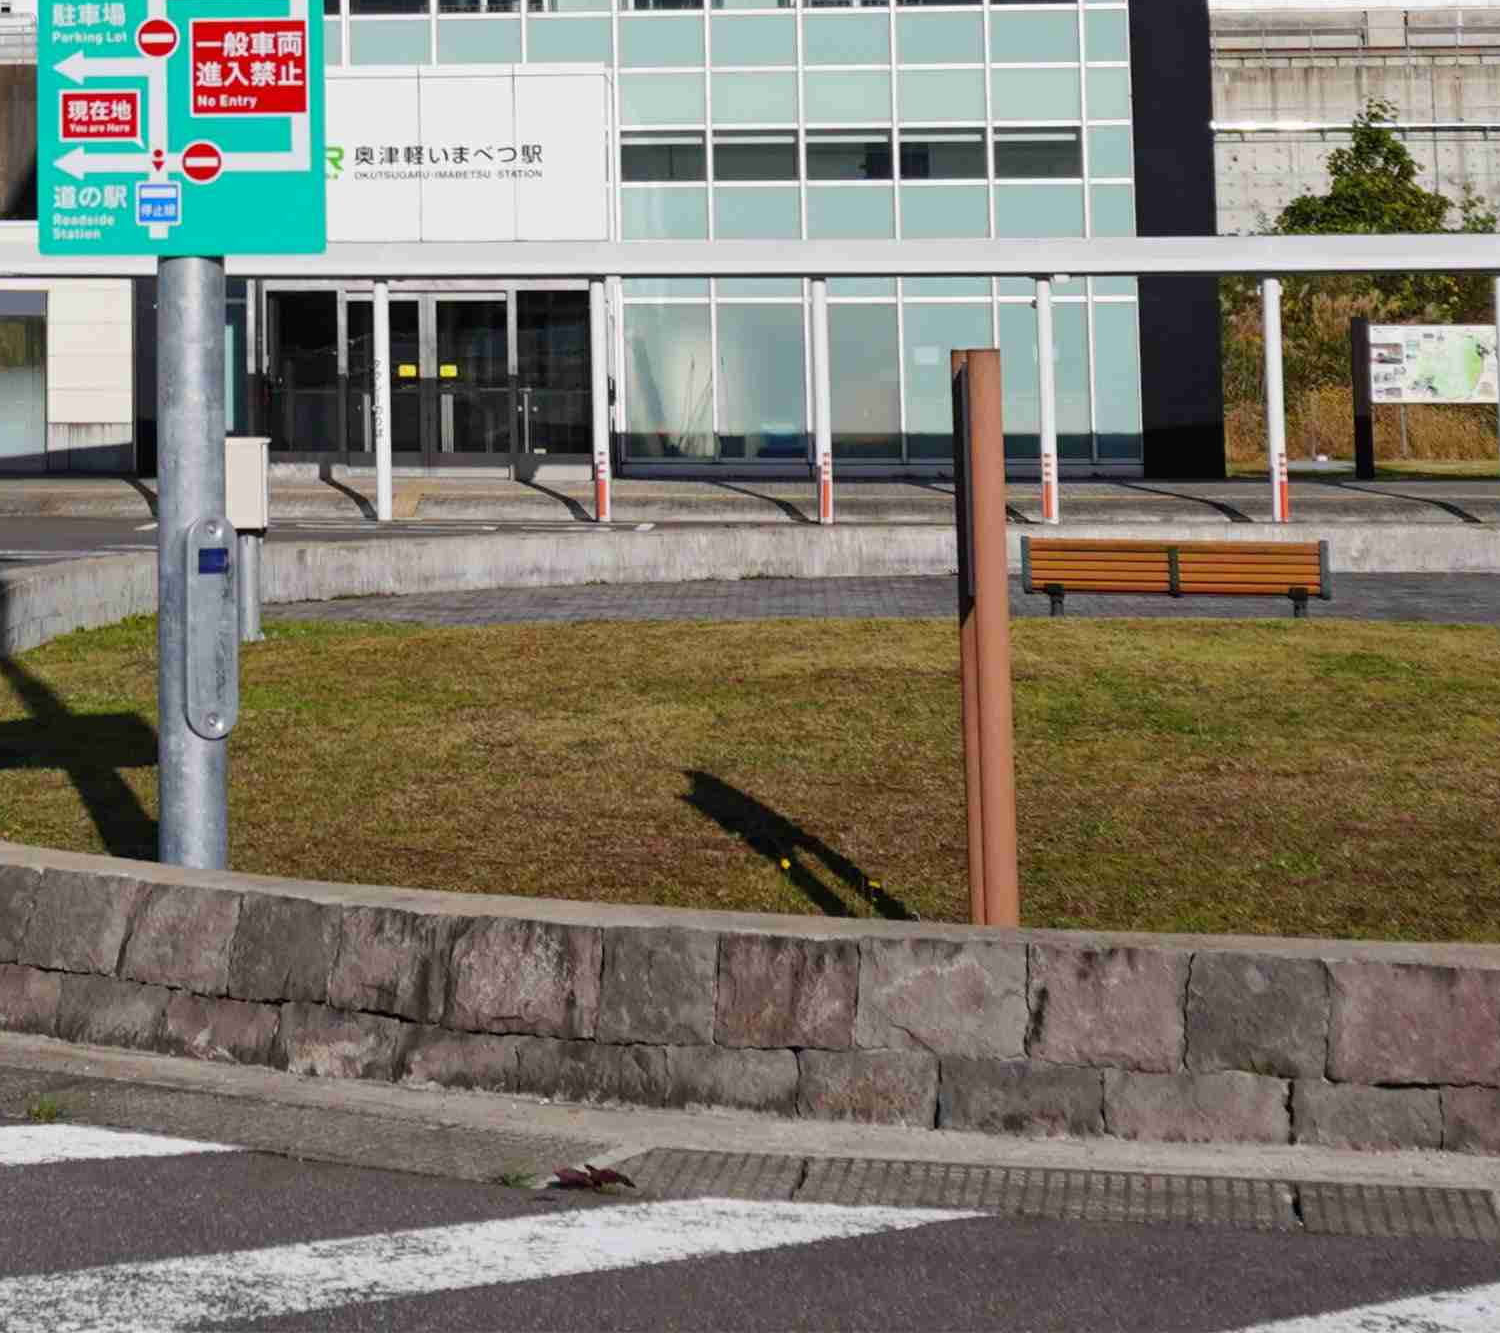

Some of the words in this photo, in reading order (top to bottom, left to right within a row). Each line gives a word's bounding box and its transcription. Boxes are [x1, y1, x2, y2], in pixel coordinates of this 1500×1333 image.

[52, 3, 126, 27] 駐車場
[52, 32, 103, 45] Parking
[107, 32, 127, 43] Lot
[196, 31, 304, 58] 一般車両
[196, 61, 304, 88] 進入禁止
[67, 100, 132, 120] 現在地
[197, 95, 217, 108] No
[219, 95, 258, 110] Entry
[69, 123, 87, 132] You
[107, 123, 131, 132] Here
[354, 144, 543, 165] 奥津軽いまべつ駅
[497, 169, 543, 179] STATION
[53, 185, 128, 209] 道の駅
[53, 213, 115, 226] Roadside
[53, 228, 101, 240] Station
